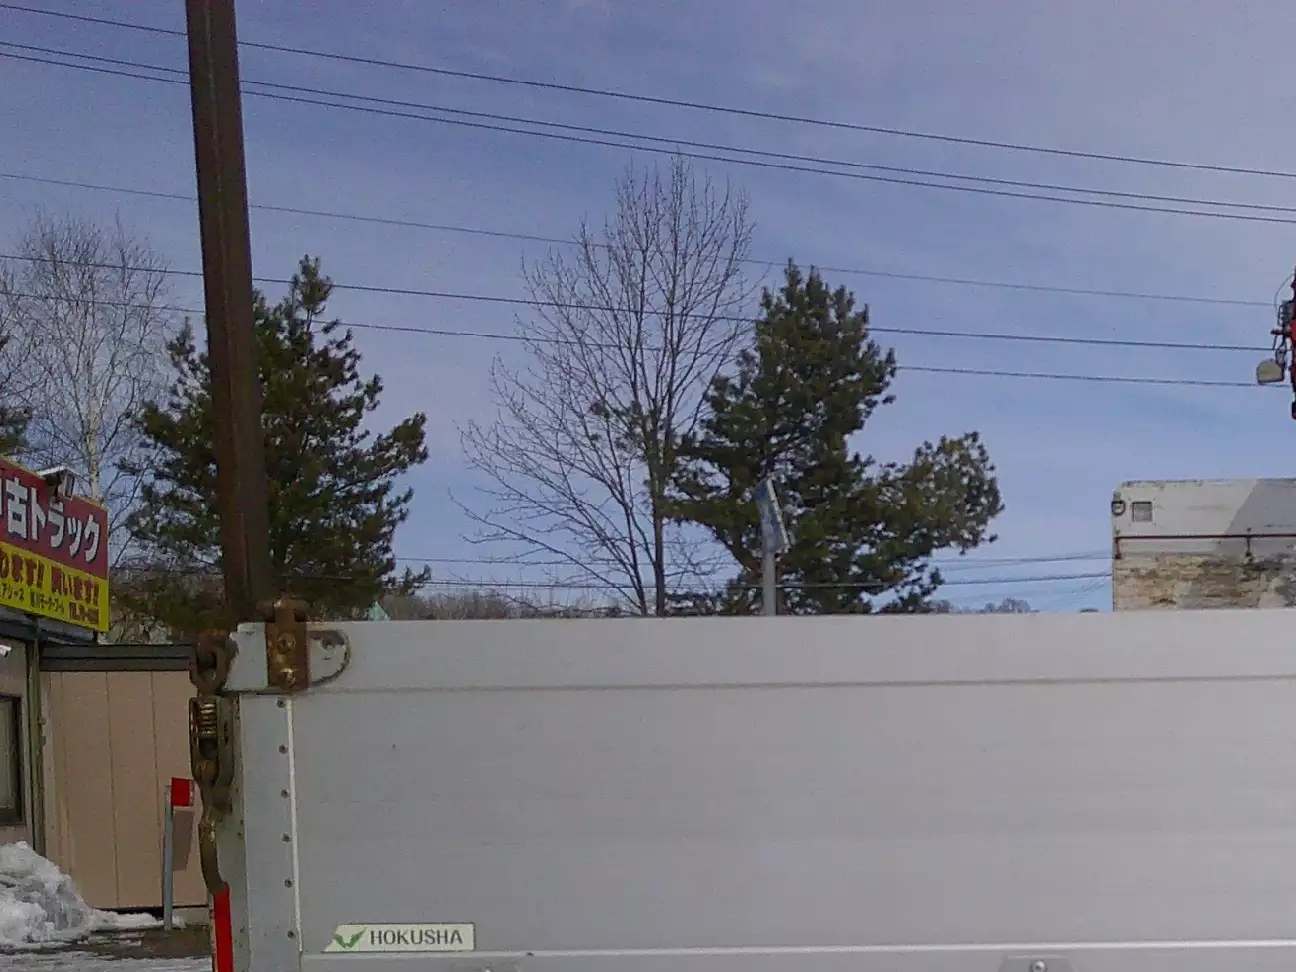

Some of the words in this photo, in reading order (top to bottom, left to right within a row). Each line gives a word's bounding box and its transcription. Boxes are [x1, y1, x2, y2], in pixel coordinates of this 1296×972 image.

[0, 476, 100, 563] 古トラック
[370, 928, 464, 945] HOKUSHA
